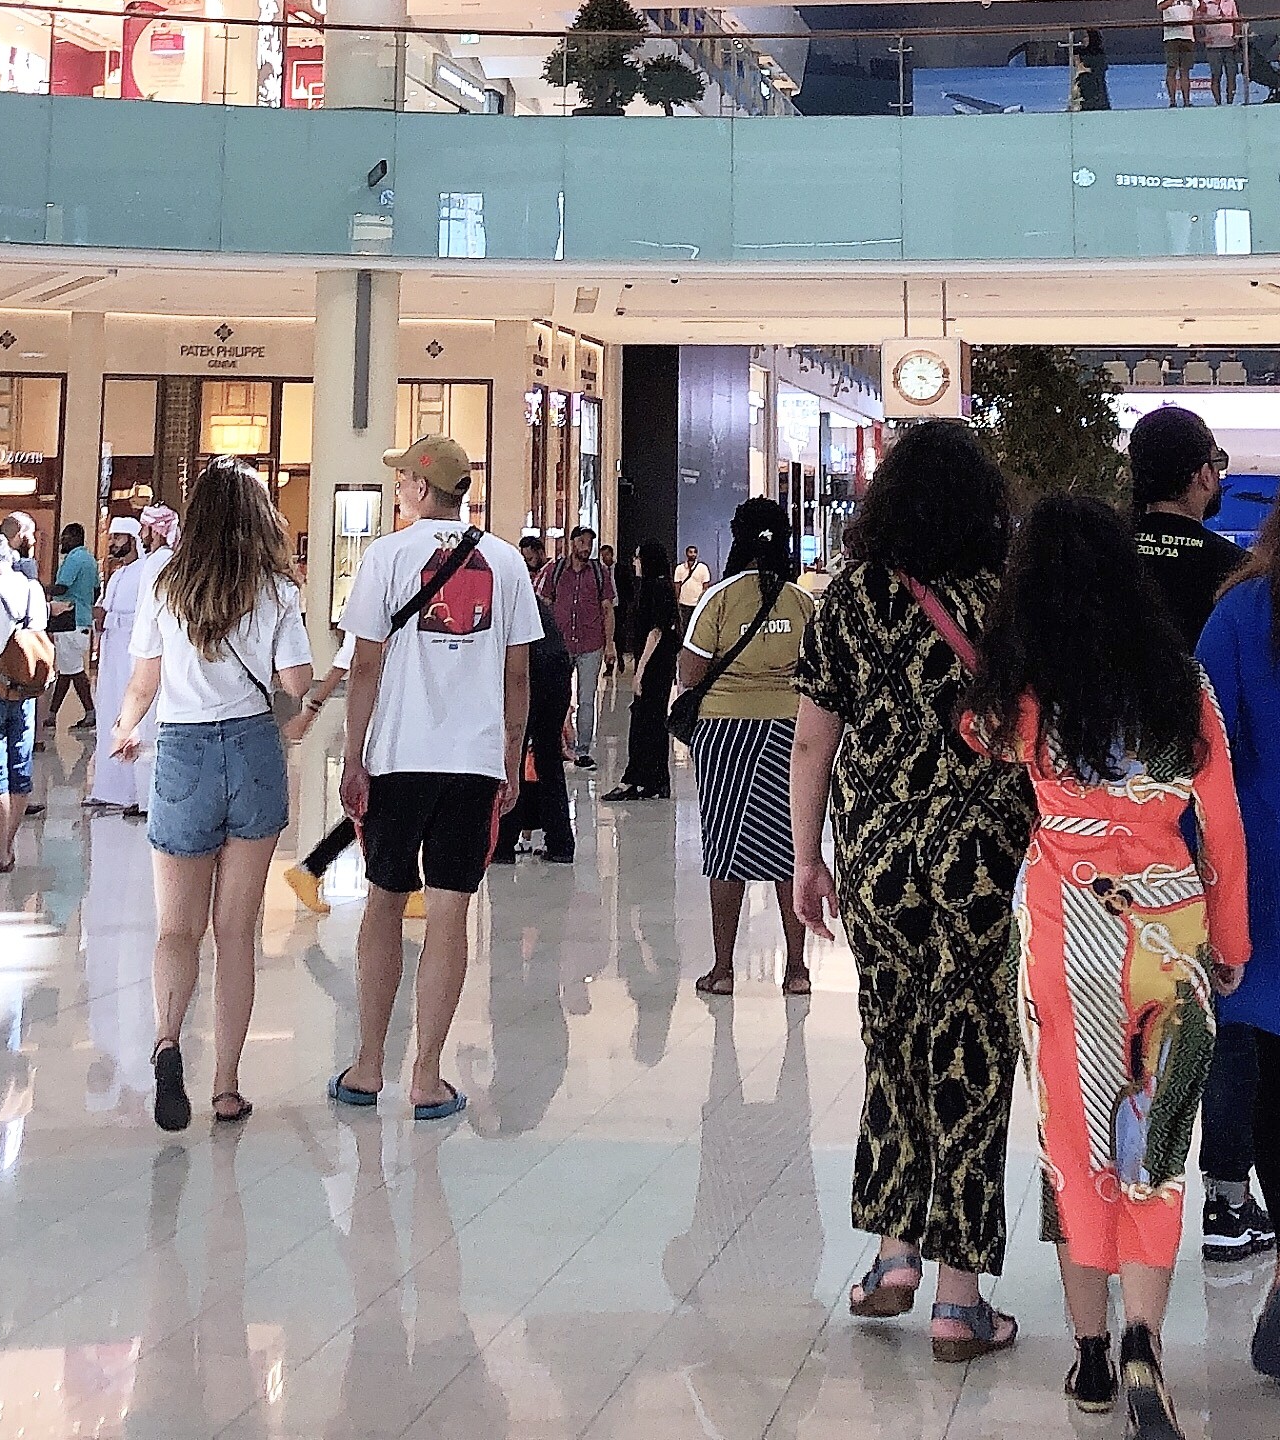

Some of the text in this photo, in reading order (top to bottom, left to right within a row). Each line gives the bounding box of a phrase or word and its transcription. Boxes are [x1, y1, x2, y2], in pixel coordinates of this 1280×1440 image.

[180, 345, 266, 358] PATEK PHILIPPE
[1161, 534, 1204, 548] EDITION
